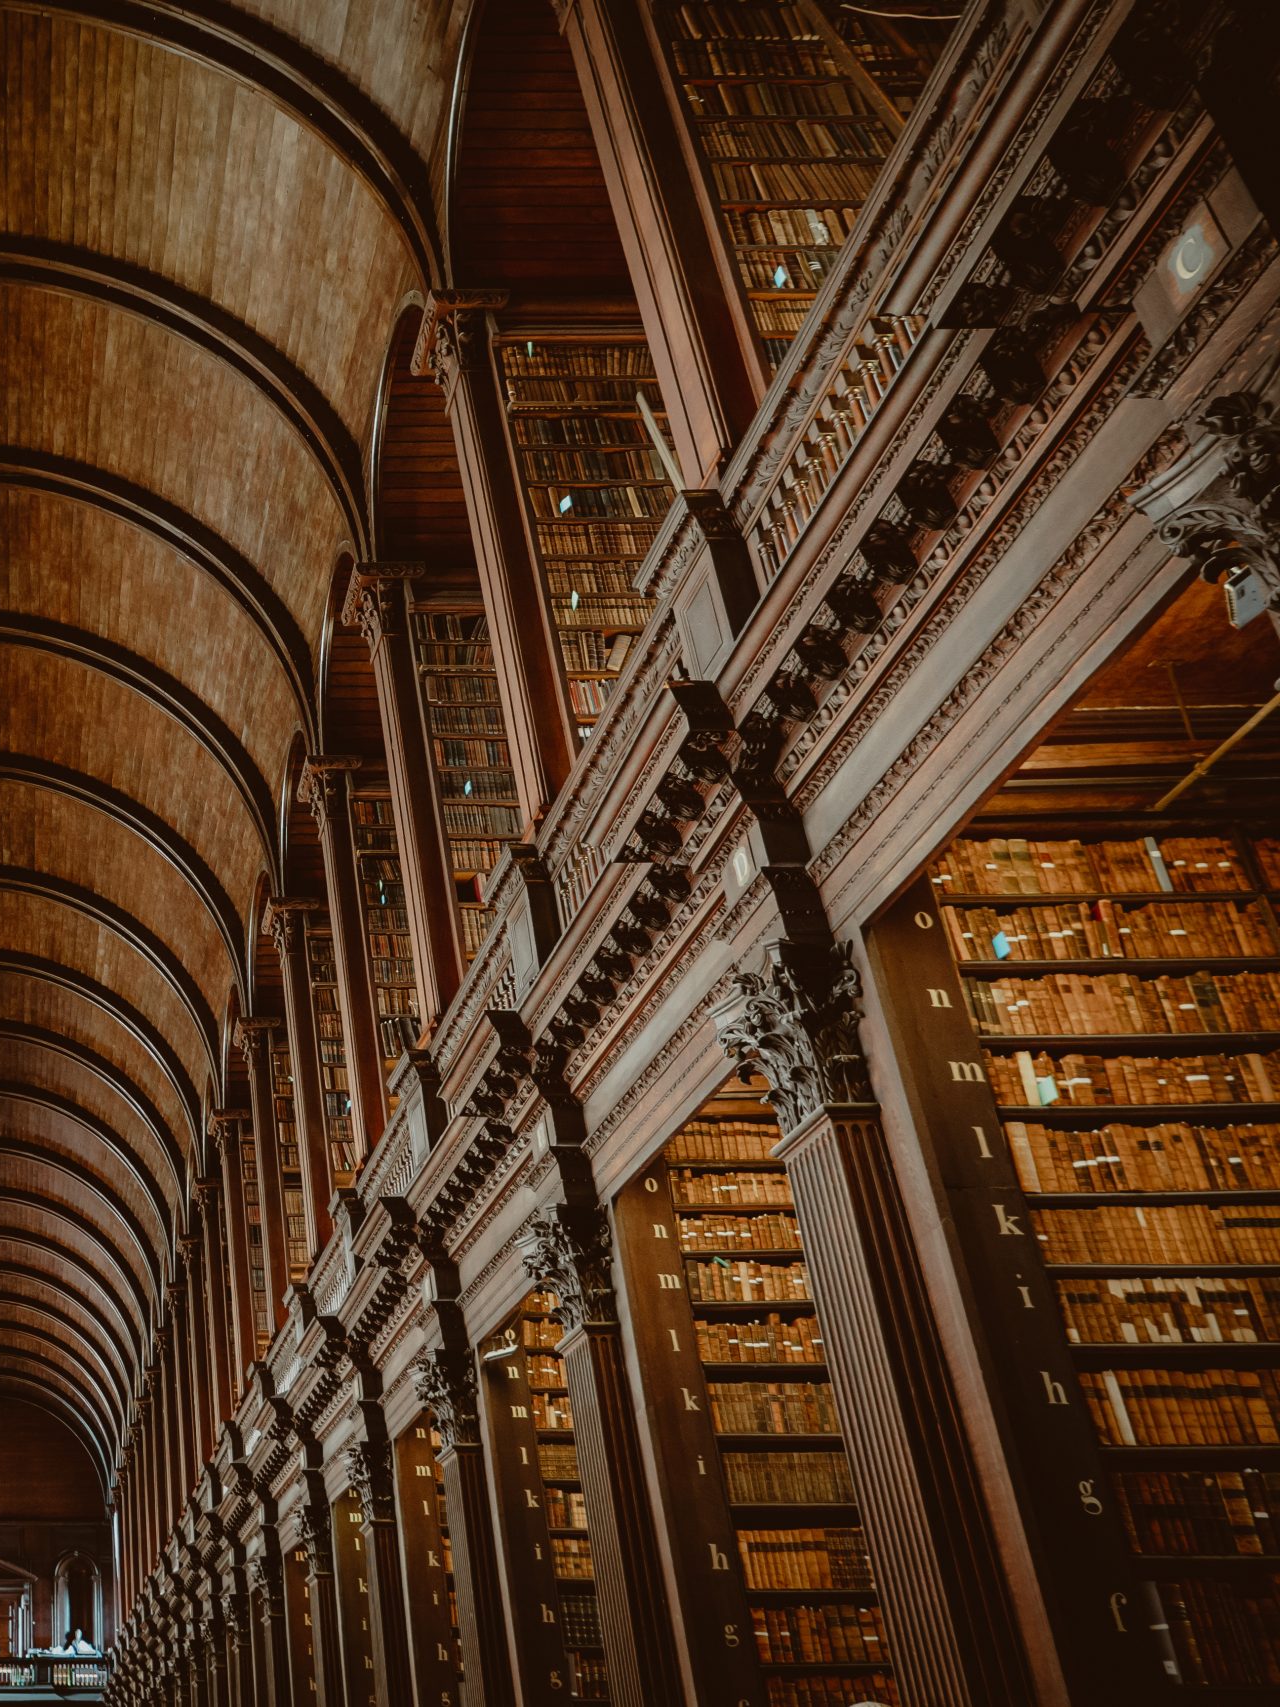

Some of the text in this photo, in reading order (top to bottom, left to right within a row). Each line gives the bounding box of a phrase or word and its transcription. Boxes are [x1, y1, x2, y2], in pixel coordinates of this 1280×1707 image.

[734, 853, 748, 880] D
[915, 912, 933, 929] o
[927, 989, 952, 1007] n
[948, 1061, 985, 1082] m
[972, 1127, 992, 1158] l
[645, 1178, 658, 1192] o
[992, 1205, 1024, 1235] k
[653, 1224, 668, 1238] n
[657, 1274, 681, 1288] m
[1016, 1274, 1034, 1308] i
[505, 1328, 516, 1341] o
[669, 1330, 680, 1351] l
[507, 1367, 520, 1378] n
[1040, 1371, 1069, 1404] h
[680, 1388, 700, 1410] k
[511, 1406, 527, 1418] m
[416, 1428, 426, 1438] n
[520, 1447, 528, 1464] l
[697, 1455, 706, 1474] i
[416, 1466, 431, 1476] m
[525, 1490, 539, 1507] k
[1079, 1480, 1102, 1514] g
[349, 1513, 362, 1522] m
[428, 1551, 440, 1566] k
[708, 1544, 729, 1569] h
[541, 1604, 555, 1623] h
[1111, 1593, 1127, 1632] f
[725, 1625, 739, 1646] g
[438, 1643, 448, 1660] h
[550, 1671, 562, 1689] g
